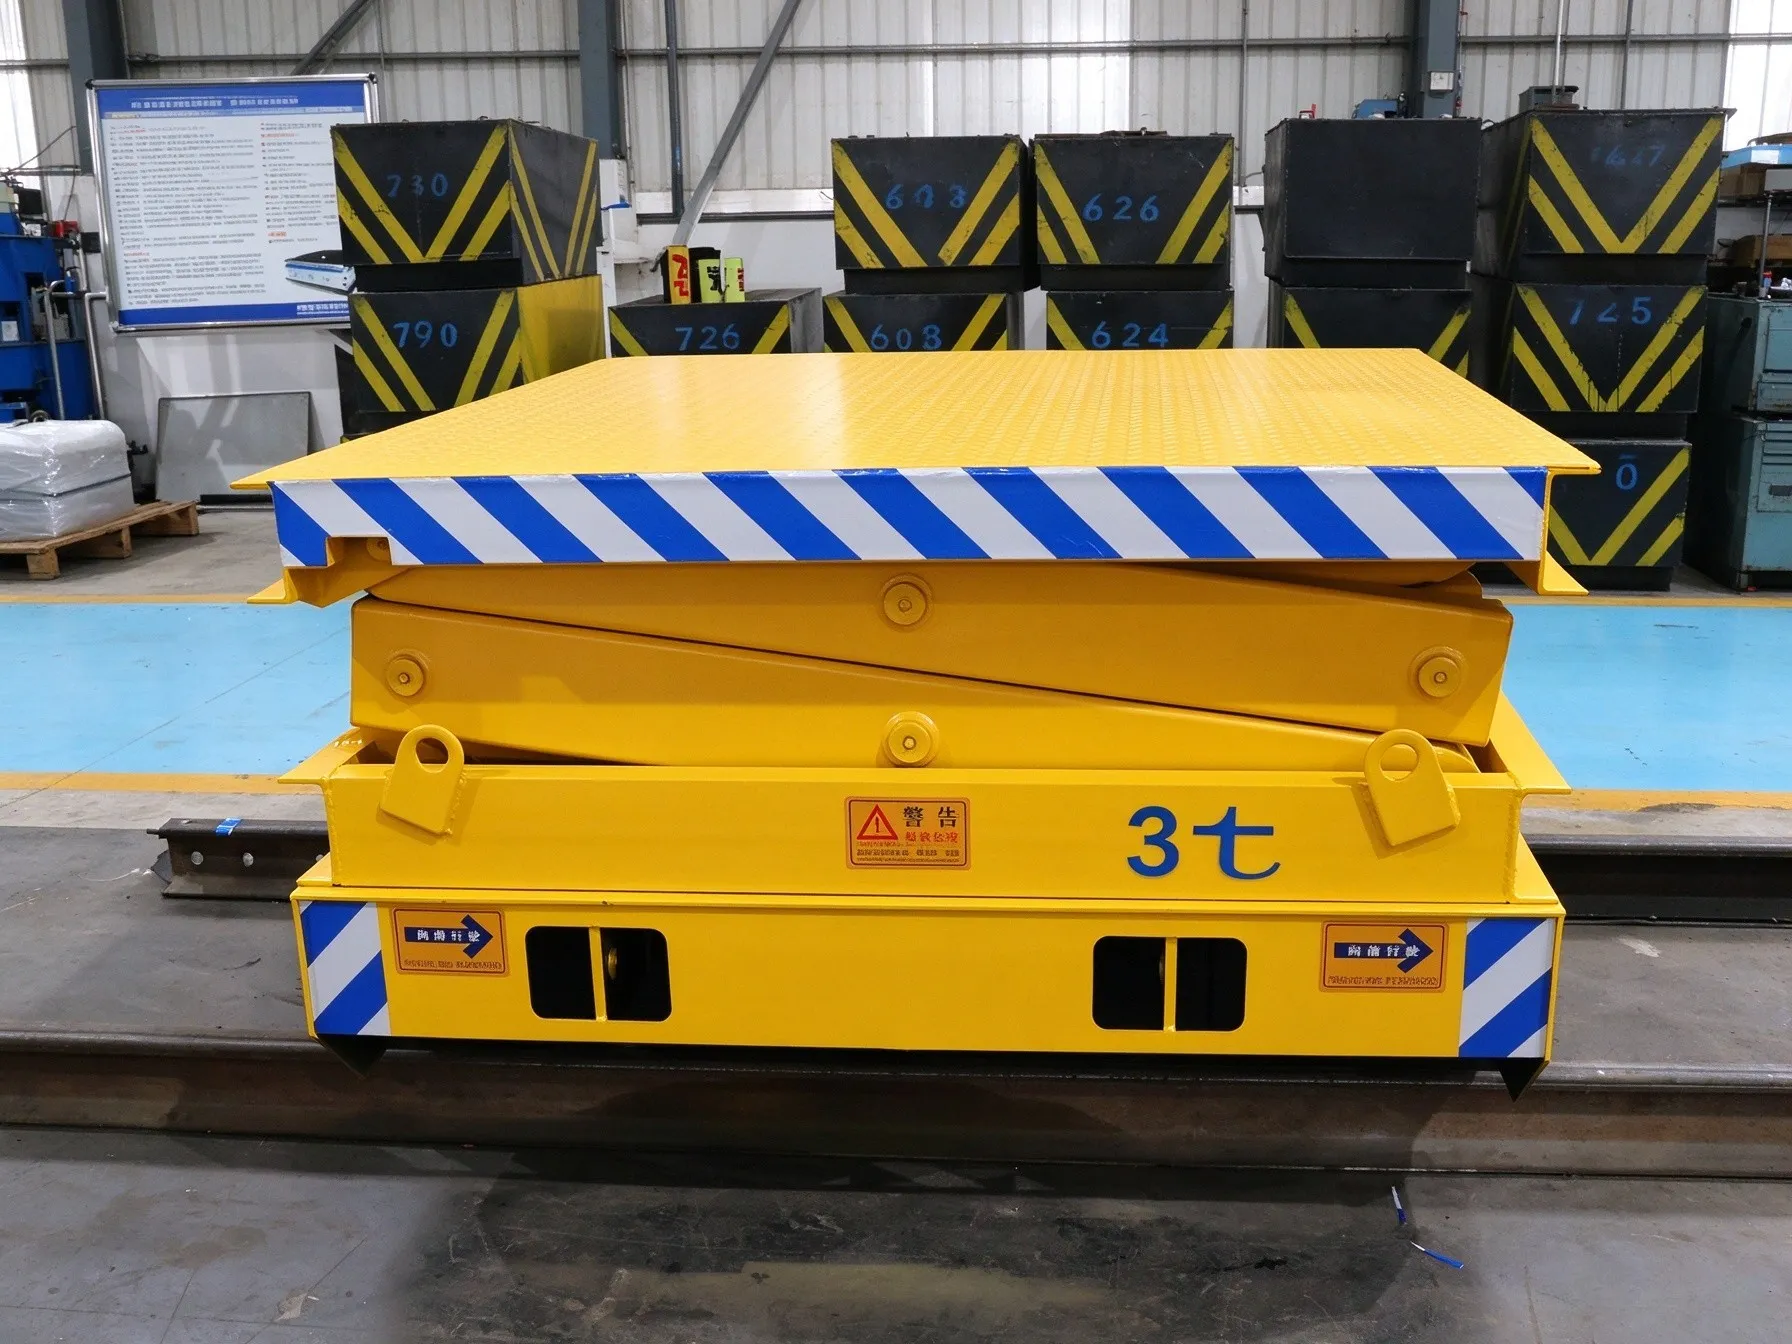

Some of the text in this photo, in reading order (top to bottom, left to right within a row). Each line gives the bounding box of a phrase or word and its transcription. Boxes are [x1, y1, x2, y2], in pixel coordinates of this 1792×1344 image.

[386, 173, 448, 198] 730
[1082, 192, 1160, 222] 626
[393, 319, 458, 348] 790
[674, 323, 741, 352] 726
[870, 323, 942, 350] 608
[1091, 320, 1169, 349] 624
